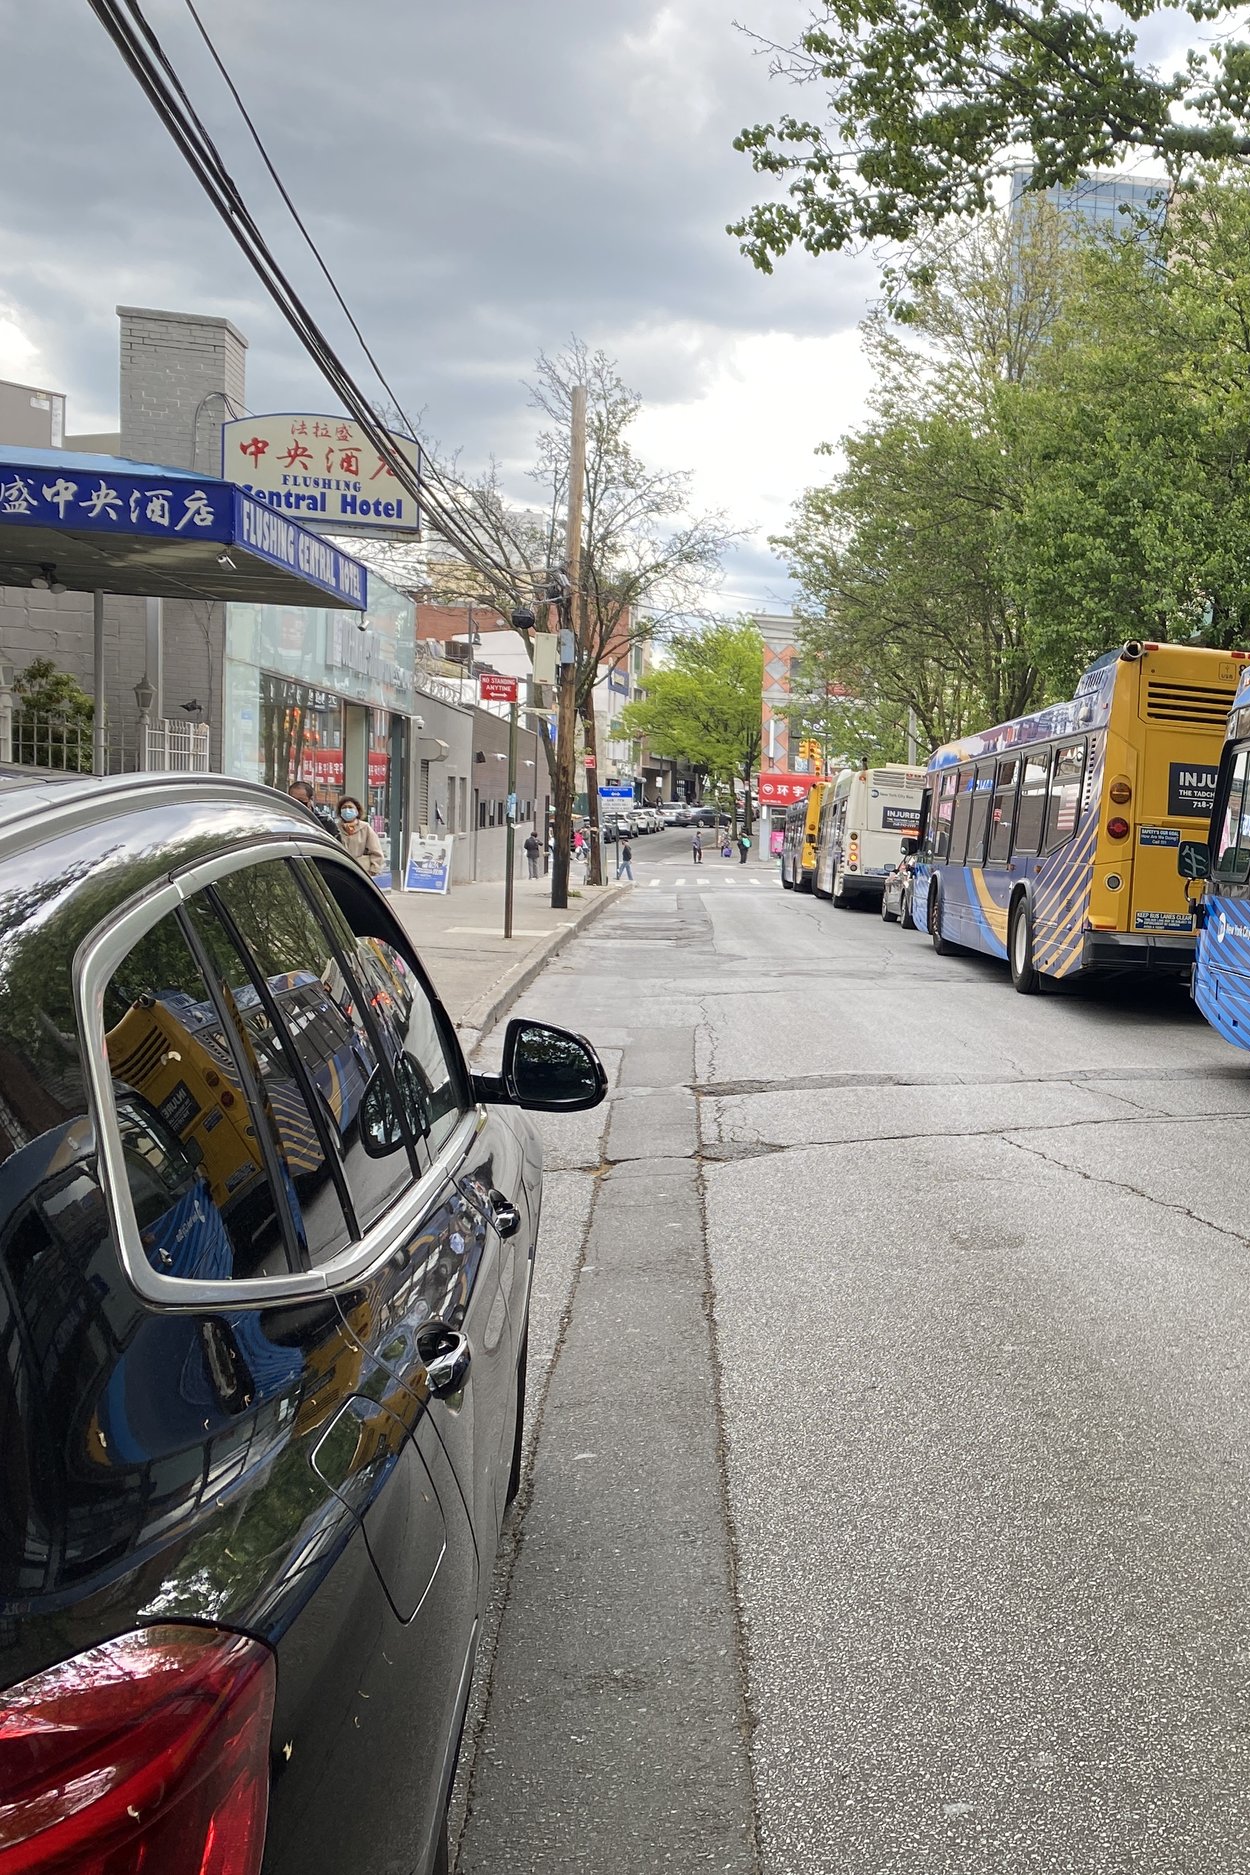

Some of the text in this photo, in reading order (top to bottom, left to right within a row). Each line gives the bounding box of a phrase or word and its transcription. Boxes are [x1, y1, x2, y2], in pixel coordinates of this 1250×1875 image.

[290, 420, 353, 442] 法拉盛
[282, 474, 361, 493] FLUSHING
[0, 474, 215, 531] 盛中央酒店
[341, 493, 403, 519] Hotel
[243, 498, 361, 601] FLUSHING CENTRAL HOTEL
[1179, 771, 1218, 788] INJU
[1193, 790, 1215, 798] TADCH
[1192, 801, 1214, 809] 718-7
[886, 810, 920, 820] INJURED
